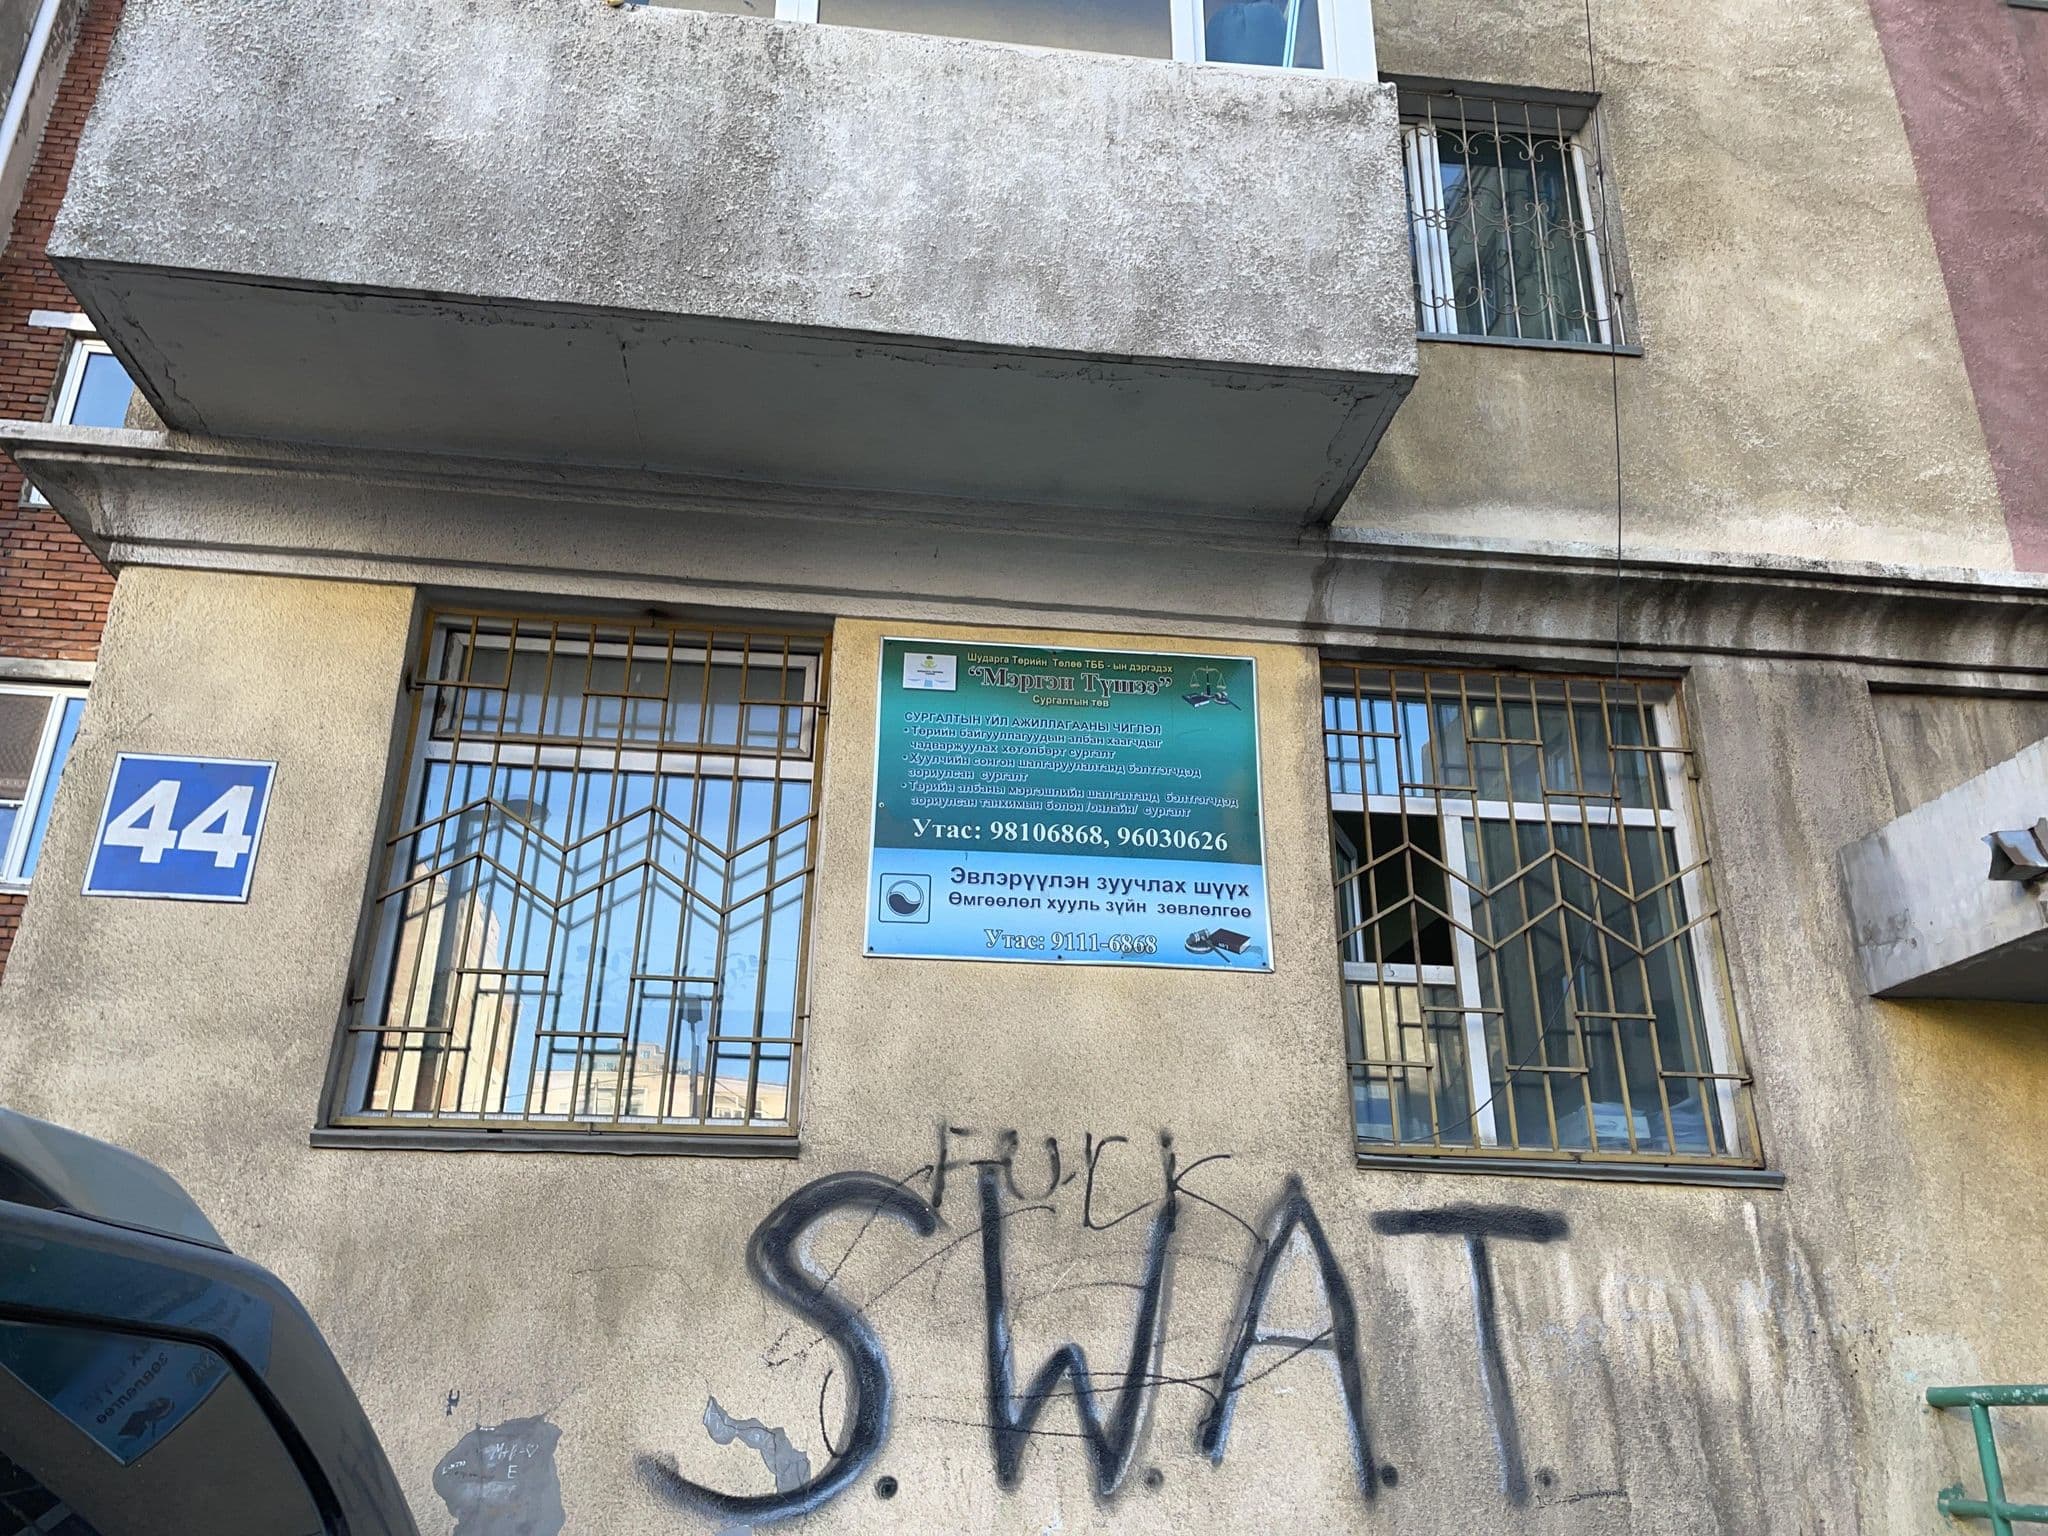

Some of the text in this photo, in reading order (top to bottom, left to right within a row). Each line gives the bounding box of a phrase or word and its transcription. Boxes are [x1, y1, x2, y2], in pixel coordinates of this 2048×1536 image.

[967, 652, 1010, 665] Шударга
[1012, 654, 1048, 668] Төрийн
[1052, 657, 1082, 669] Төлөө
[1085, 659, 1104, 669] ТББ
[1113, 663, 1127, 671] ын
[1129, 663, 1173, 674] дэргэдэх
[1033, 694, 1110, 708] Сургалтын төв
[904, 711, 981, 726] СУРГАЛТЫН
[1011, 717, 1109, 732] АЖИЛЛАГААНЫ
[1112, 722, 1162, 735] ЧИГЛЭЛ
[911, 725, 1163, 750] Төрийн байгууллагуудын албан хаагчдыг
[910, 740, 1116, 760] чадваржуулах хөтөлбөрт сургалт
[908, 768, 1029, 782] зориулсан сургалт
[909, 753, 1202, 779] Хуулчийн сонгон шалгаруулалтанд бэлтгэгчдэд
[910, 779, 955, 794] Төрийн
[958, 783, 1006, 795] албаны
[1008, 786, 1084, 800] мэргэшлийн
[1087, 788, 1160, 803] шалгалтанд
[911, 796, 977, 808] зориулсан
[980, 799, 1042, 811] танхимын
[1045, 799, 1084, 812] болон
[1143, 806, 1191, 819] сургалт
[103, 779, 255, 868] 44
[912, 818, 1229, 852] Утас: 98106868, 96030626
[950, 866, 1250, 899] Эвлэрүүлэн зуучлах шүүх
[948, 891, 1252, 919] Өмгөөлөл хууль зүйн зөвлөлгөө
[984, 928, 1158, 955] Утас: 9111-6868
